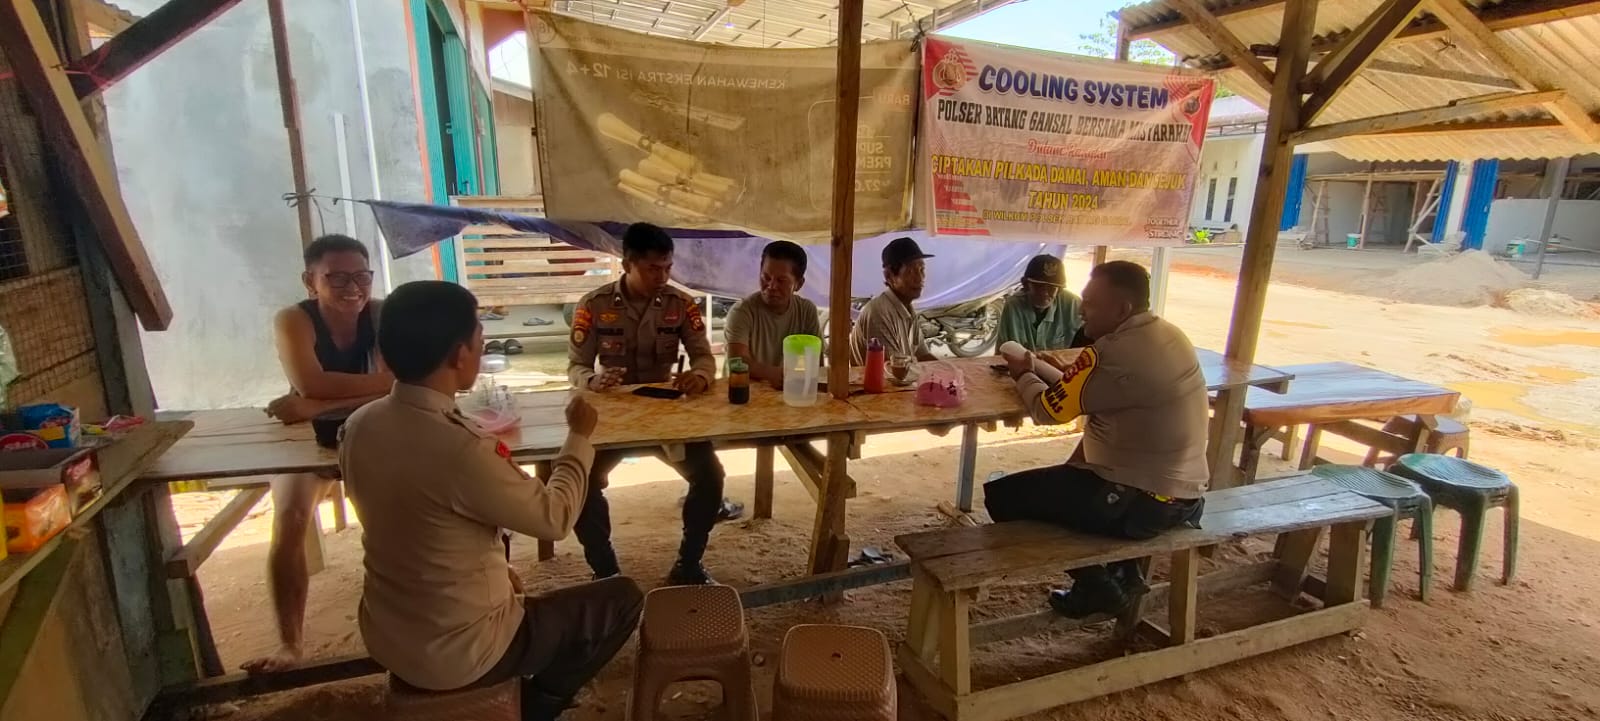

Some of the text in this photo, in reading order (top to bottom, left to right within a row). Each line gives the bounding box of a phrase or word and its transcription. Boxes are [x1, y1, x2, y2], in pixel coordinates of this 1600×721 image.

[978, 64, 1169, 109] COOLING SYSTEM
[937, 98, 982, 124] POLSEK
[985, 105, 1027, 130] BATANG
[1029, 110, 1073, 135] GANSAL
[1075, 115, 1126, 140] BERSAMA
[931, 154, 993, 178] CIPTAKAN
[994, 161, 1048, 182] PILKADA
[1049, 165, 1089, 187] DAMAI,
[1091, 169, 1127, 188] AMAN
[1028, 190, 1099, 210] TAHUN 2024
